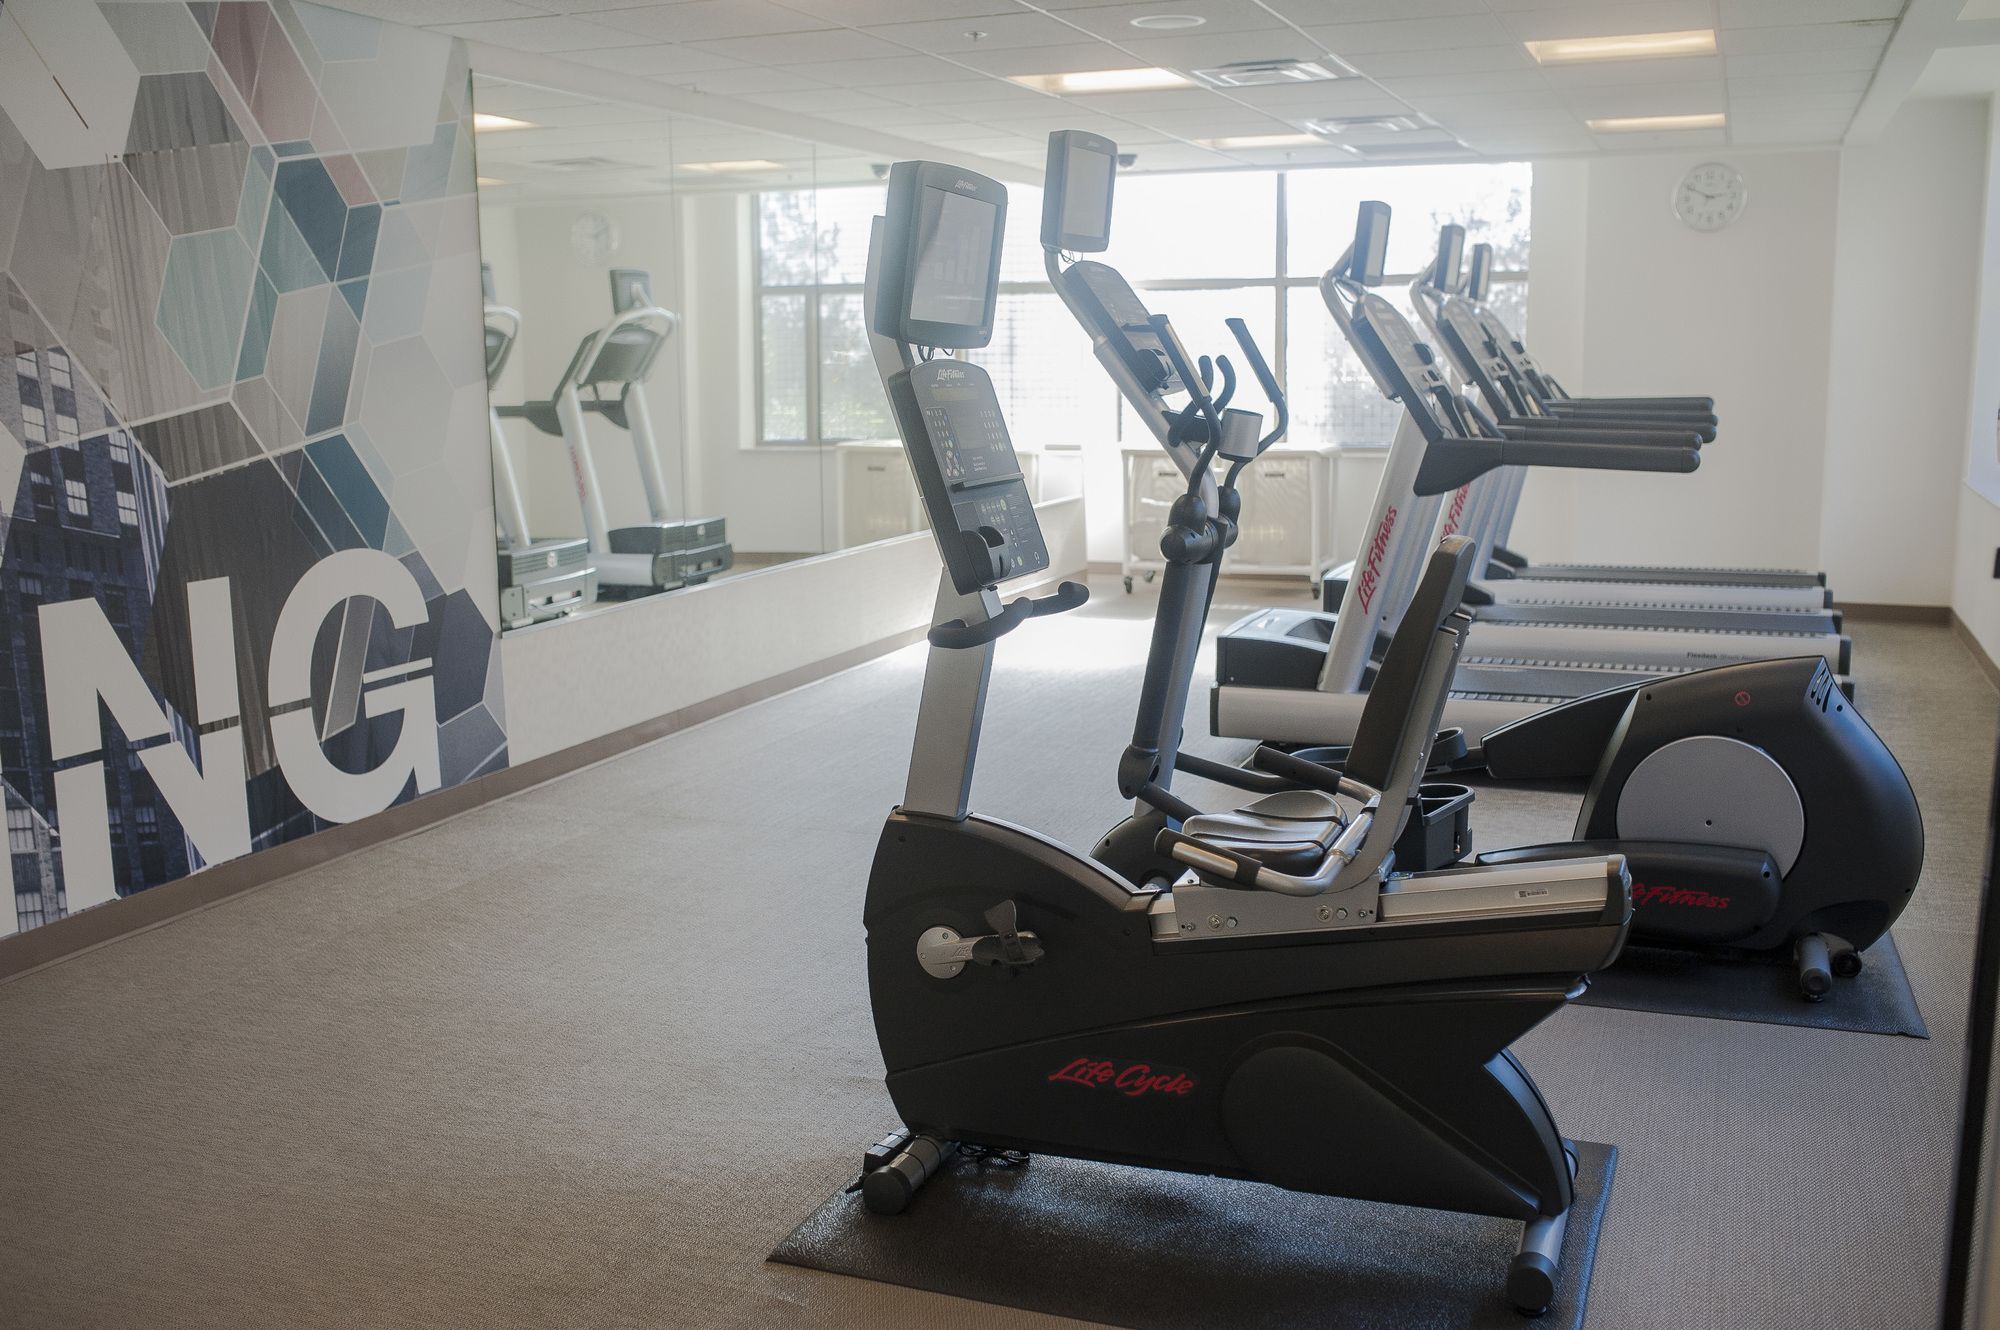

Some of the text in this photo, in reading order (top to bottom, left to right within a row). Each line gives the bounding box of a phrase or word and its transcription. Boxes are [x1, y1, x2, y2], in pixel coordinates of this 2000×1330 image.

[0, 548, 441, 939] NG
[1048, 1058, 1194, 1097] Life Cycle
